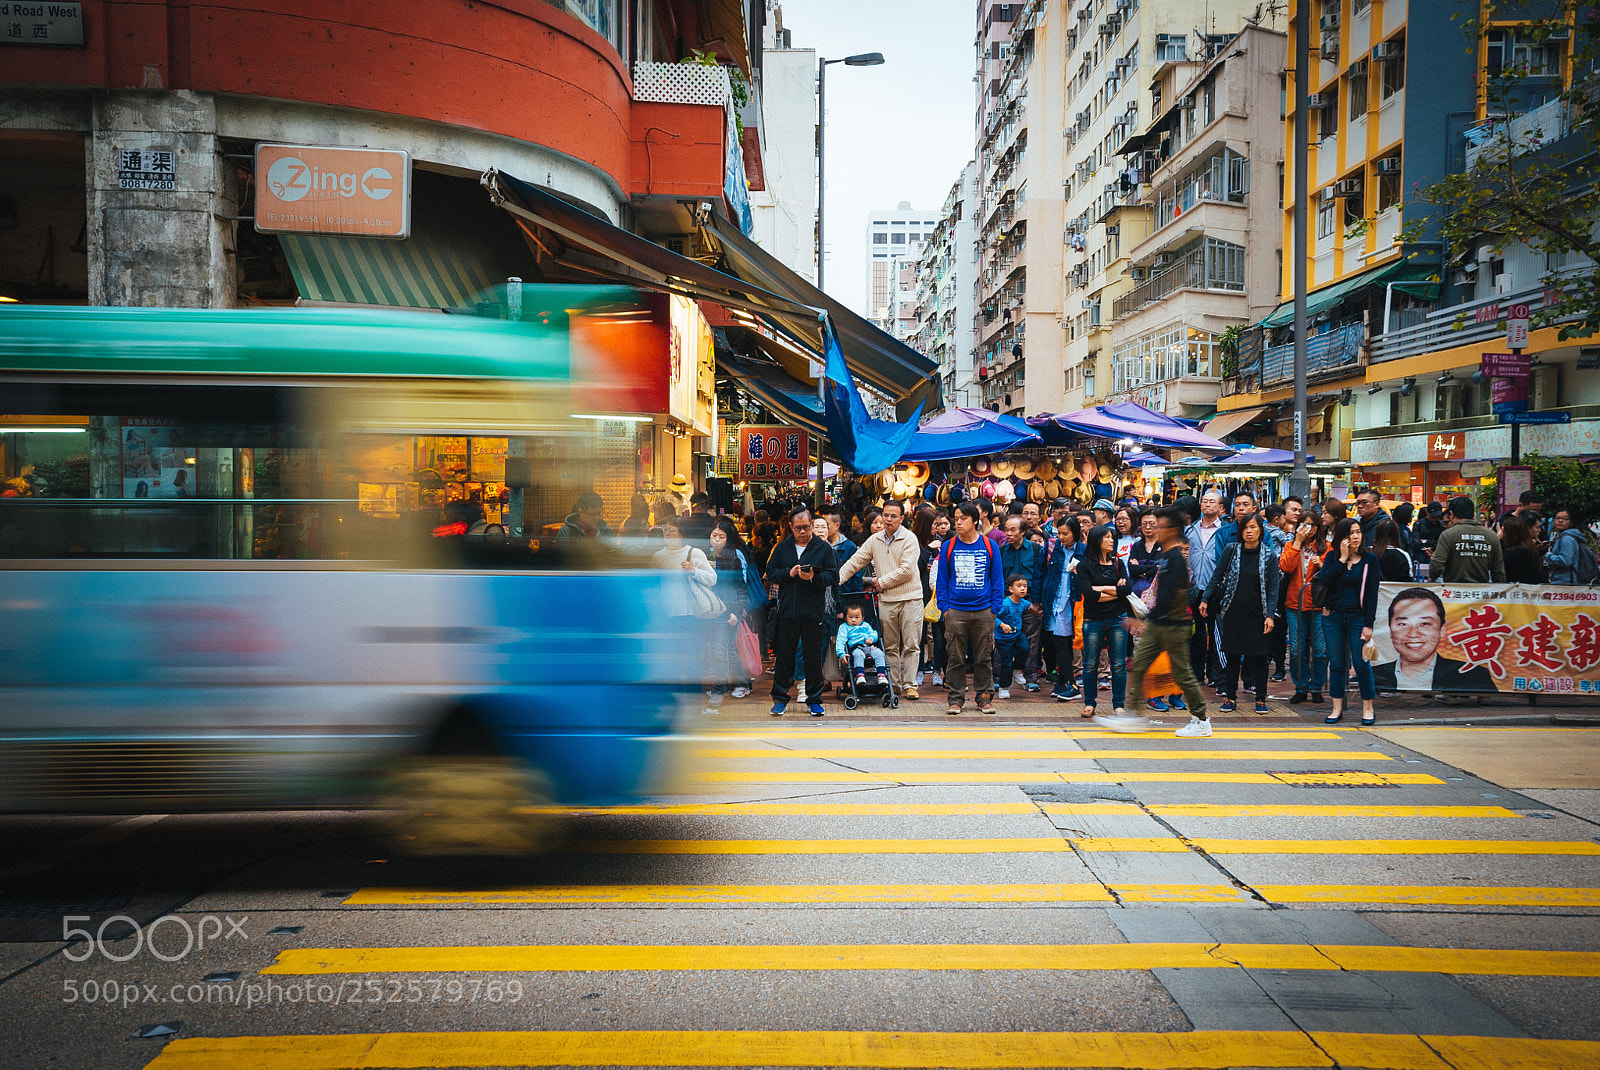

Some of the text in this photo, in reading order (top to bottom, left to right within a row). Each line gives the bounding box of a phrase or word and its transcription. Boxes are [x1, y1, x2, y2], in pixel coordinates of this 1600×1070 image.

[14, 5, 43, 16] Road
[48, 6, 77, 17] West
[8, 22, 48, 38] 道西
[123, 151, 171, 171] 通渠
[121, 179, 173, 190] 90817280
[284, 163, 357, 197] Zing
[309, 191, 340, 199] HAIR
[1475, 304, 1499, 323] KAM
[1552, 592, 1598, 601] 23946903
[1514, 676, 1575, 692] 用心建設
